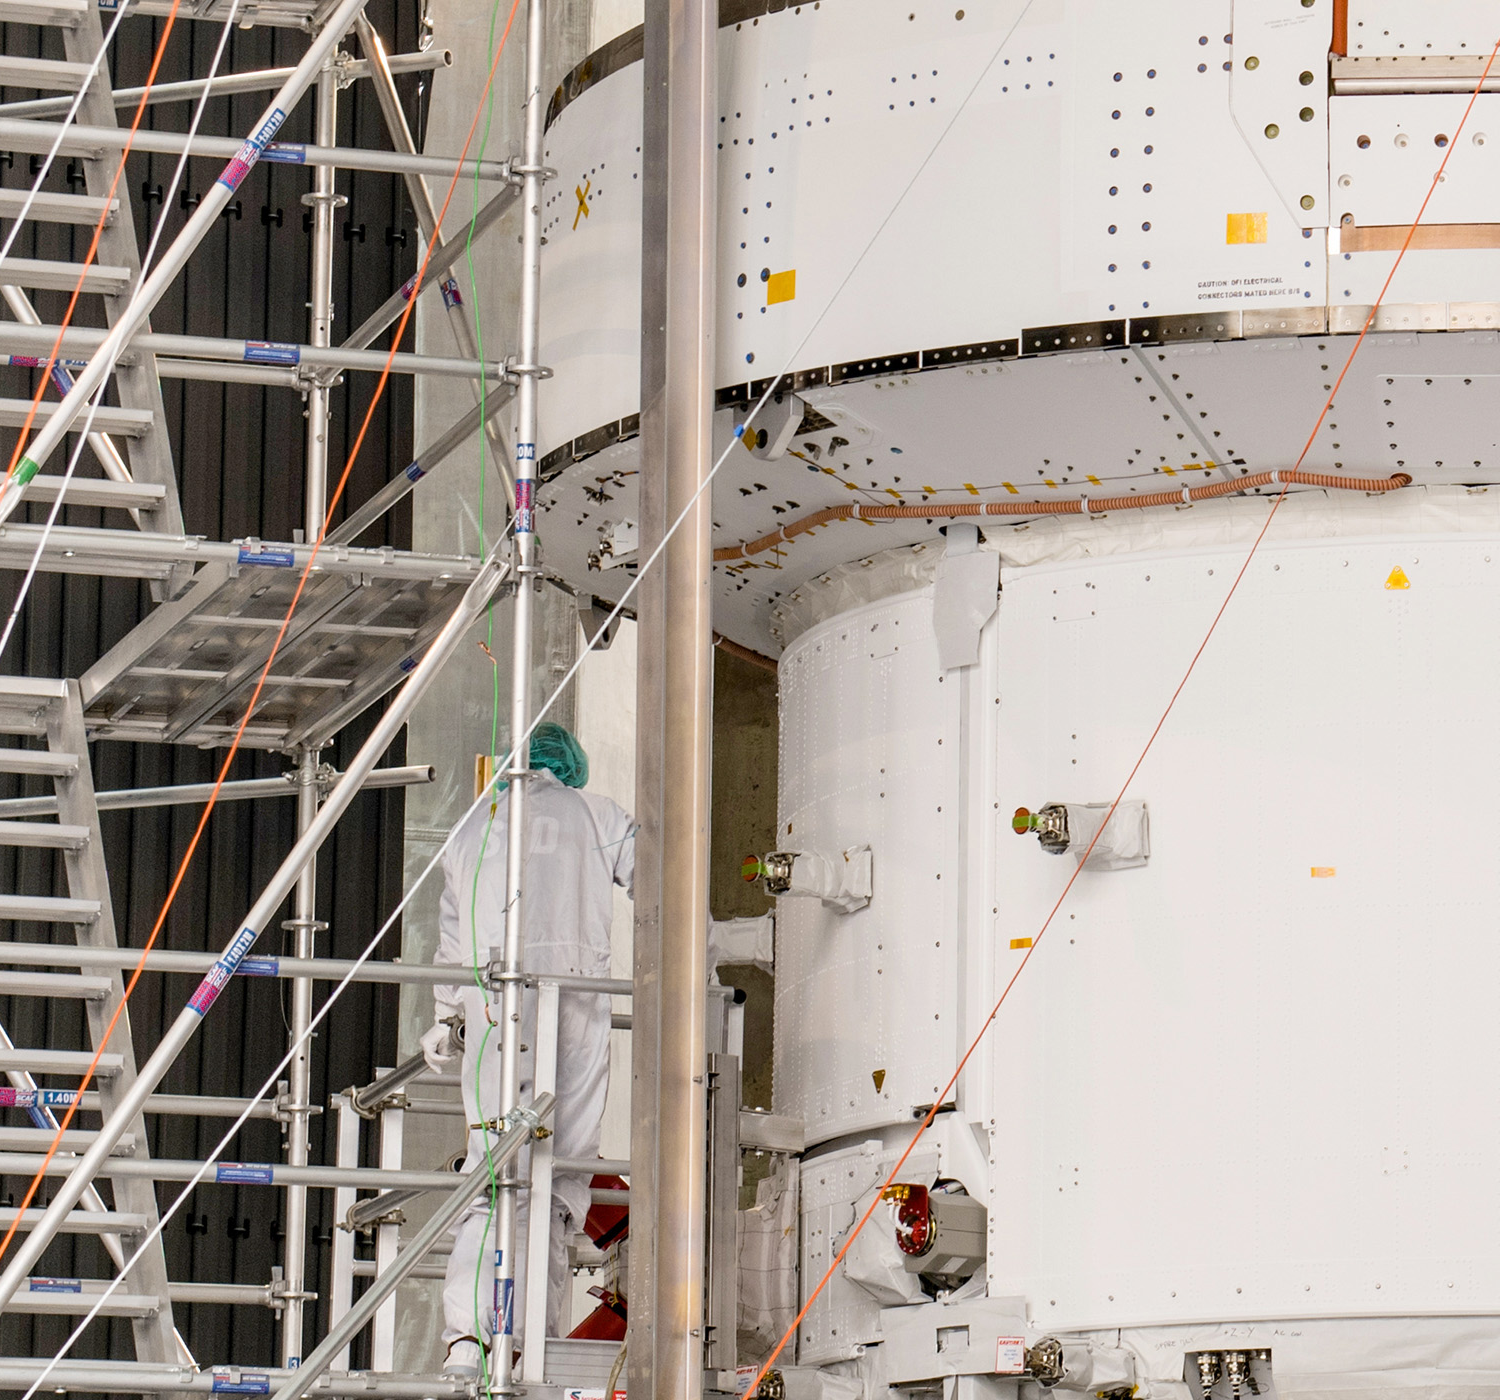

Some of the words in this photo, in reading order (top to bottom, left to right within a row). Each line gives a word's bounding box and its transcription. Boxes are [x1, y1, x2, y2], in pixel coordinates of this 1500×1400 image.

[1243, 277, 1283, 285] ELECTRICAL
[1197, 291, 1242, 300] CONNECTORS
[48, 1092, 79, 1104] 1.40M
